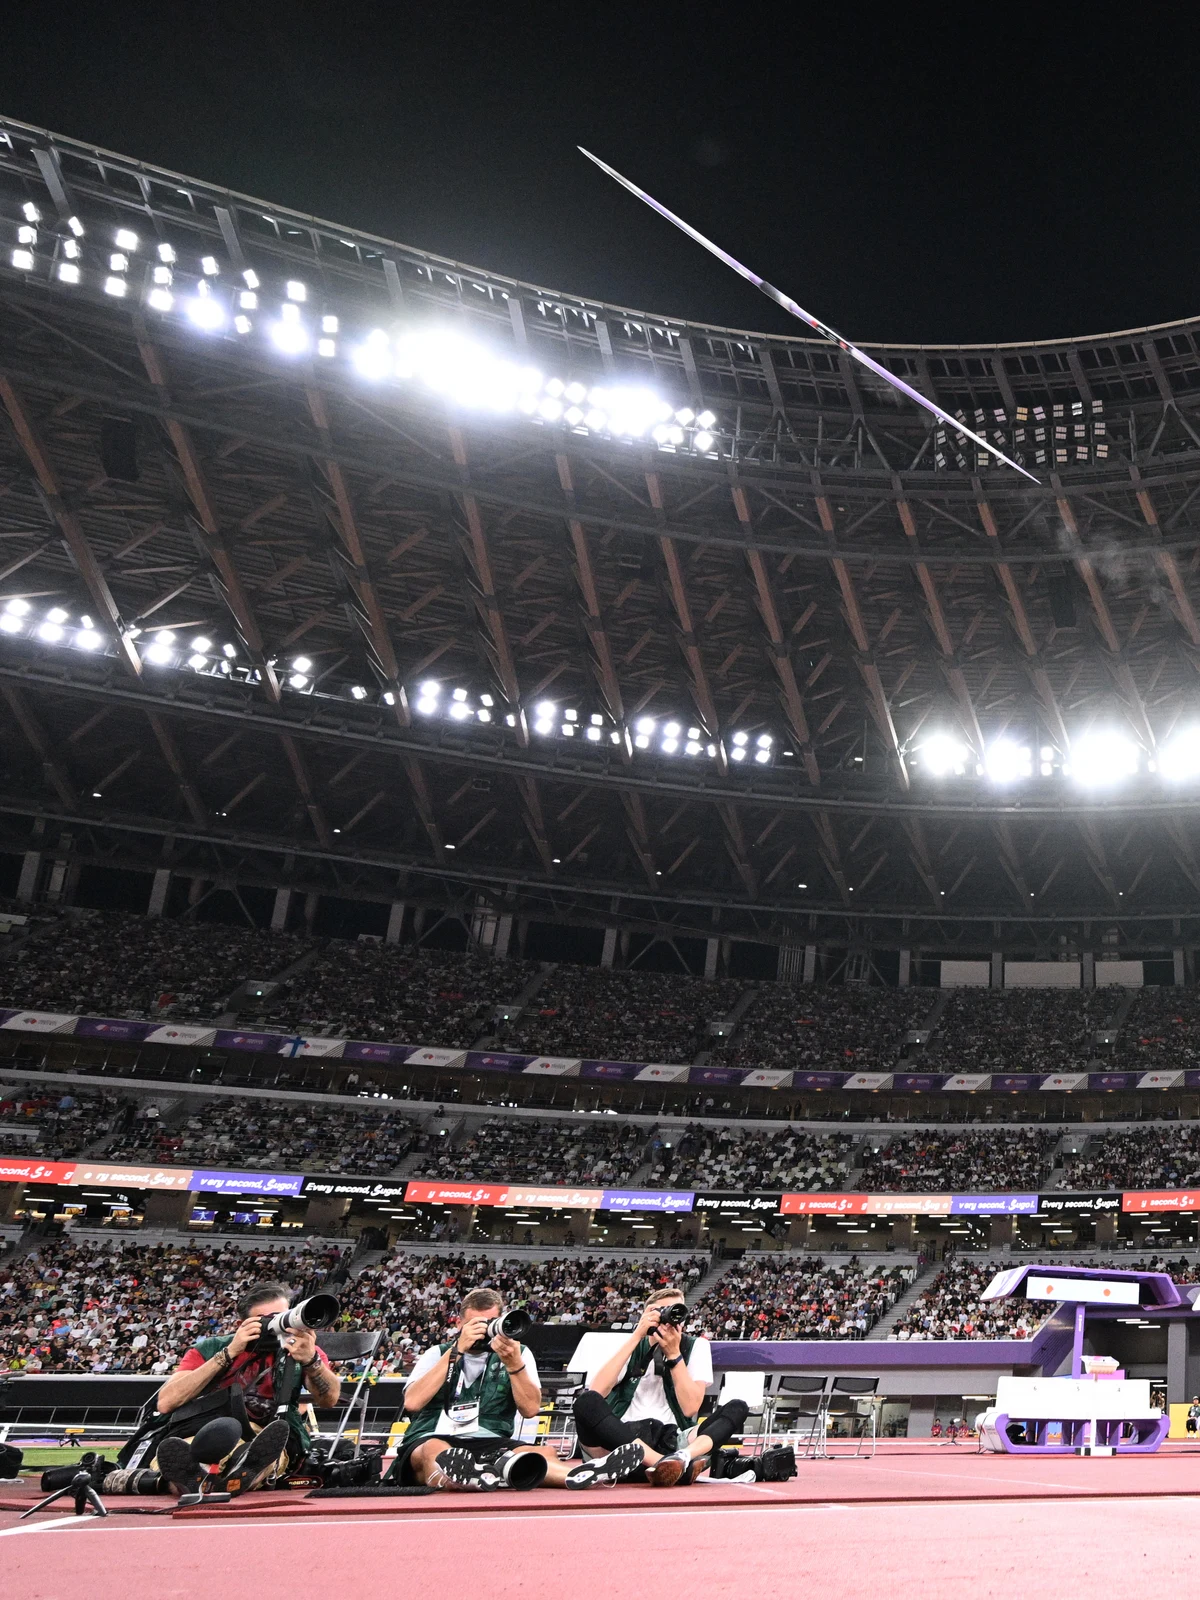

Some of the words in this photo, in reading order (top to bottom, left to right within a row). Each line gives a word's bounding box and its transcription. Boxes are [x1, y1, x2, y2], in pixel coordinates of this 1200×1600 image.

[226, 1180, 262, 1188] second,
[263, 1179, 297, 1191] Sugoi.
[305, 1183, 333, 1193] Every
[335, 1186, 370, 1194] second,
[370, 1184, 402, 1196] Sugoi.
[439, 1191, 471, 1199] second,
[662, 1196, 690, 1207] Sugoi.
[697, 1198, 719, 1208] Every
[721, 1200, 750, 1208] second,
[751, 1198, 777, 1210] Sugoi.
[976, 1201, 1005, 1209] second,
[1008, 1199, 1035, 1210] Sugoi.
[1041, 1200, 1063, 1210] Every
[1065, 1200, 1093, 1208] second,
[1094, 1198, 1119, 1209] Sugoi.
[446, 1363, 454, 1383] SONY
